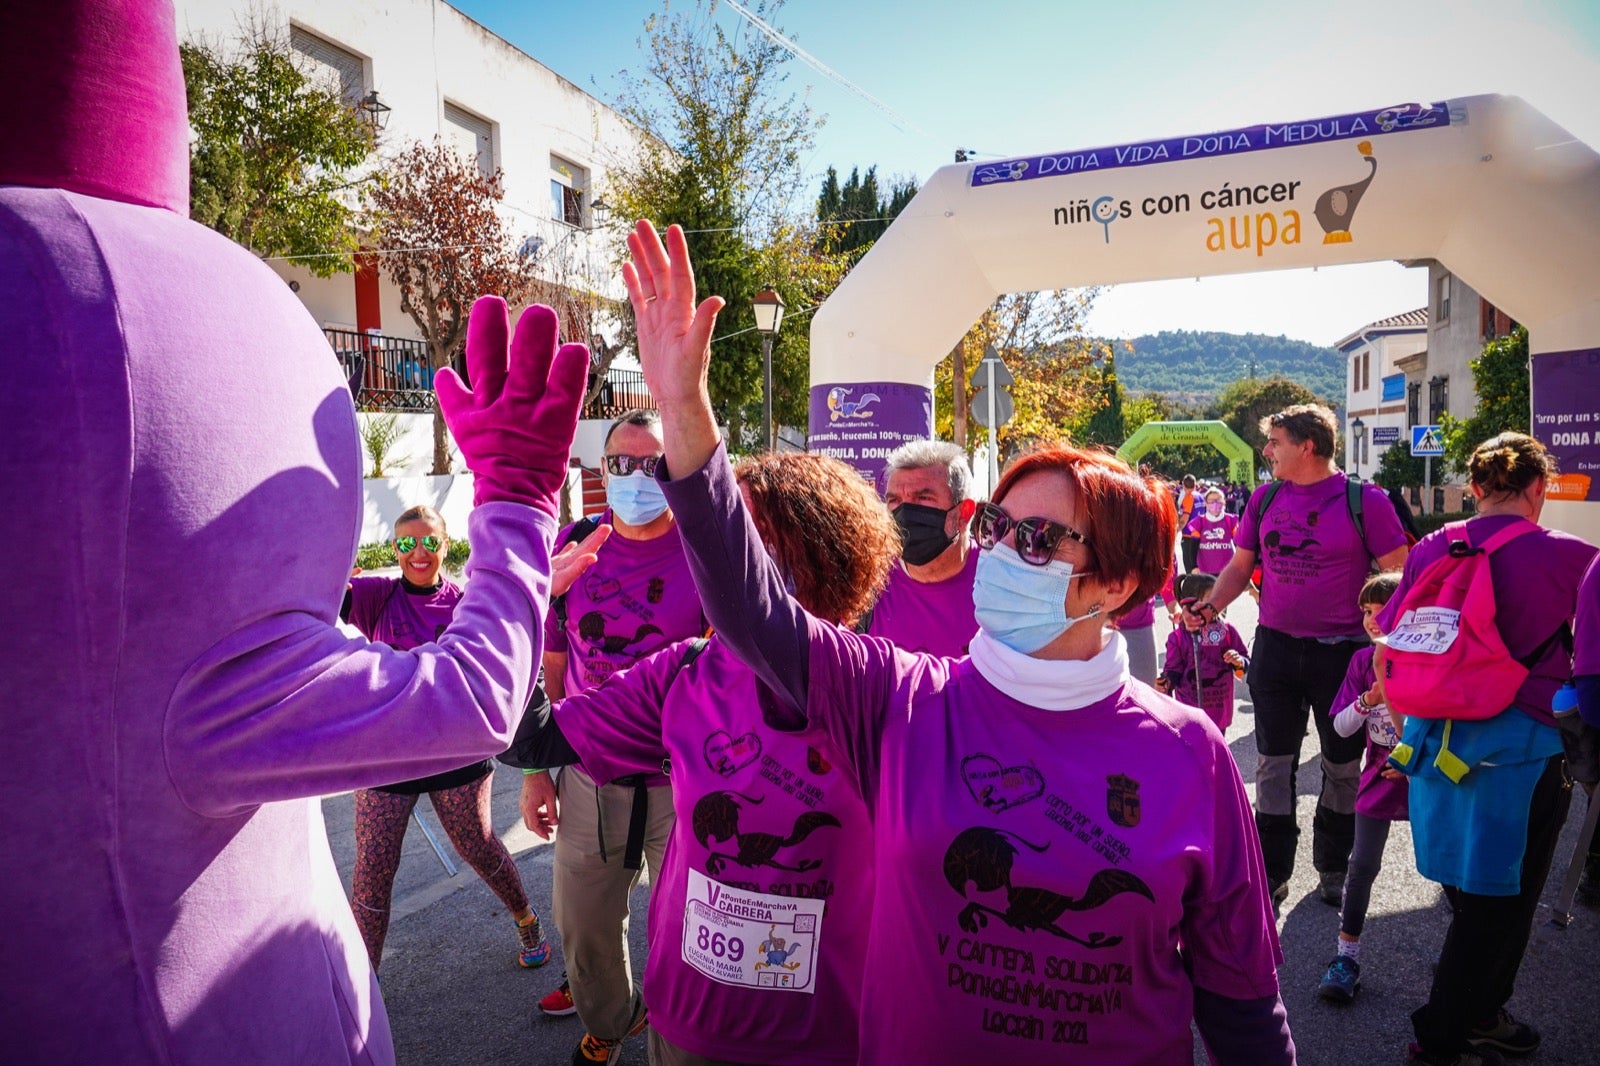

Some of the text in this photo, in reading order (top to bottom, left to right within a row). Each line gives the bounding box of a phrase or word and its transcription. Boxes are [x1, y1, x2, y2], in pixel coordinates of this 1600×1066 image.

[1142, 193, 1190, 217] con
[1200, 181, 1301, 210] cáncer
[1206, 209, 1301, 256] aupa
[1557, 413, 1573, 425] por
[1575, 412, 1591, 423] un
[841, 430, 878, 441] leucemia
[879, 430, 902, 441] 100%
[1552, 431, 1591, 447] DONA
[1395, 632, 1432, 645] 1197
[707, 880, 721, 907] V
[718, 900, 773, 921] CARRERA
[697, 925, 745, 962] 869
[937, 932, 950, 956] V
[688, 945, 743, 973] EUGENIA MARIA
[715, 968, 744, 980] ALVAREZ
[1052, 1020, 1089, 1044] 2021
